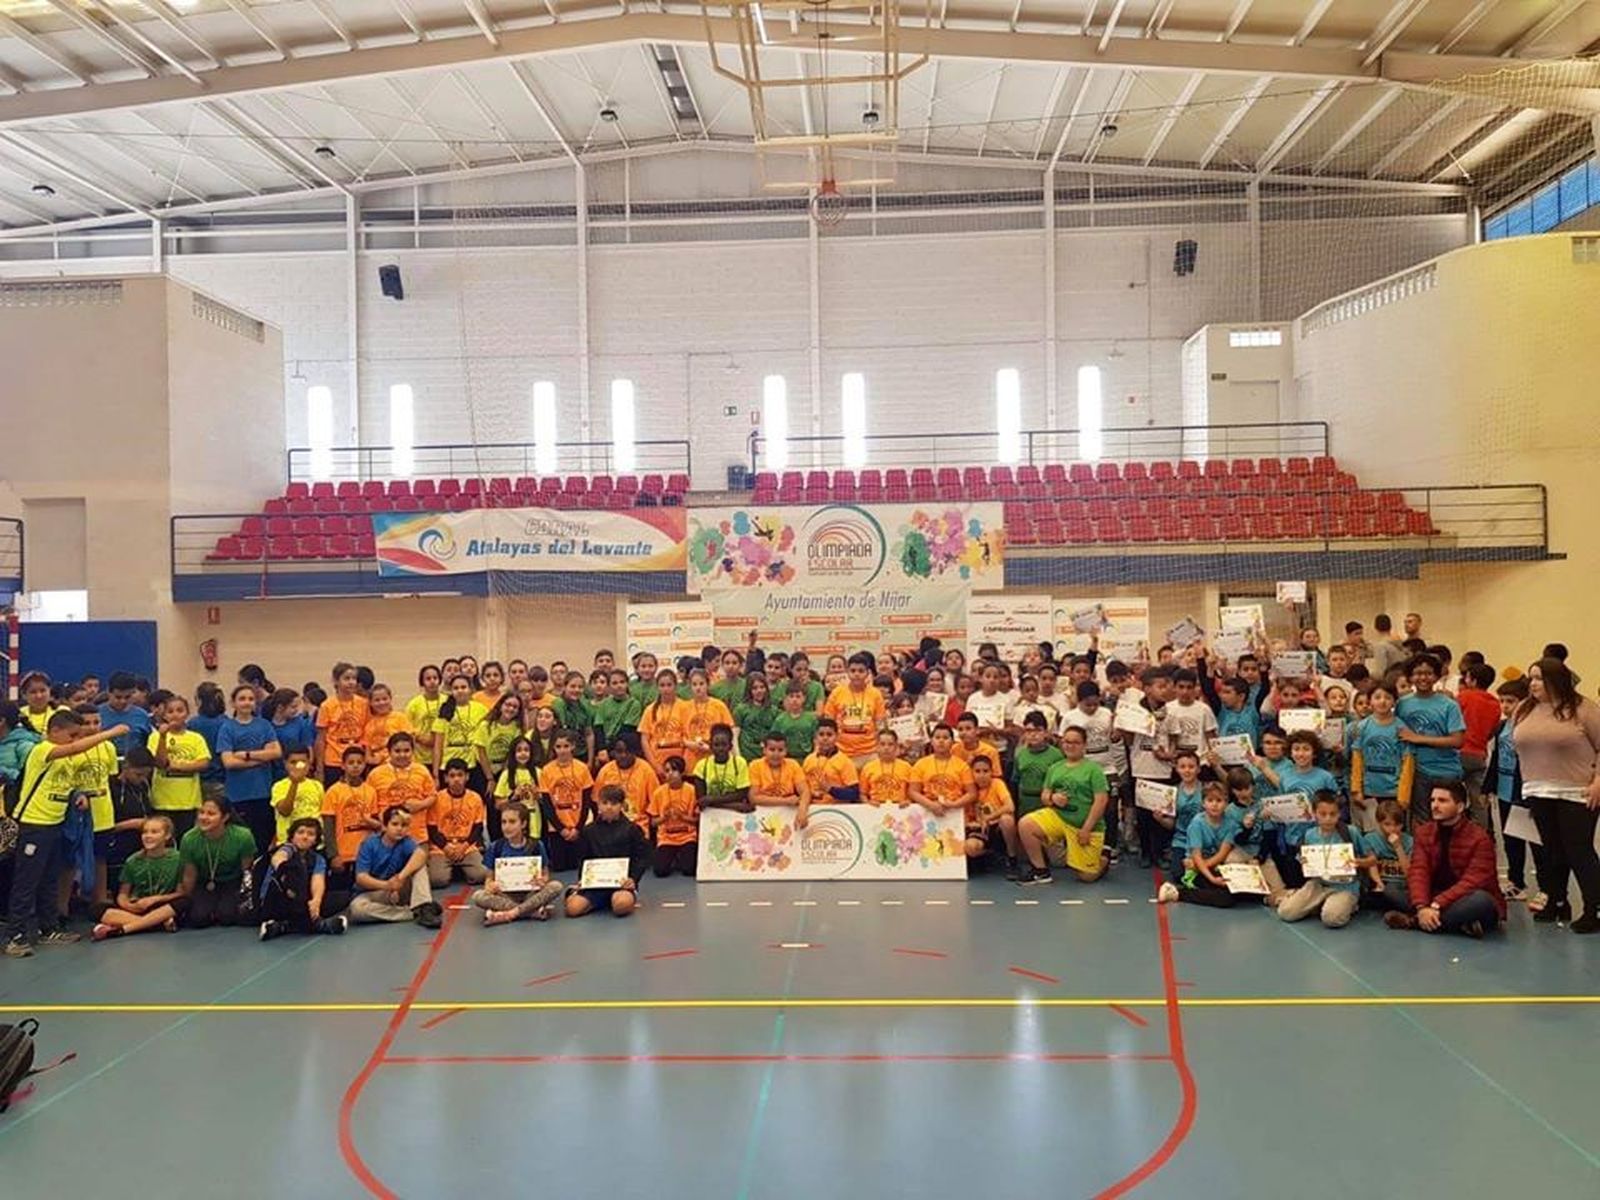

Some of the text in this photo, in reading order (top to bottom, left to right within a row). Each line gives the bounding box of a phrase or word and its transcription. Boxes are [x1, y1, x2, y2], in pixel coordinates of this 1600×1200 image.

[466, 538, 652, 558] Atalayas del Levante
[807, 542, 872, 558] OLIMPIADA
[764, 593, 855, 613] Ayuntamiento
[859, 593, 876, 608] de
[801, 839, 852, 851] OLIMPIADA
